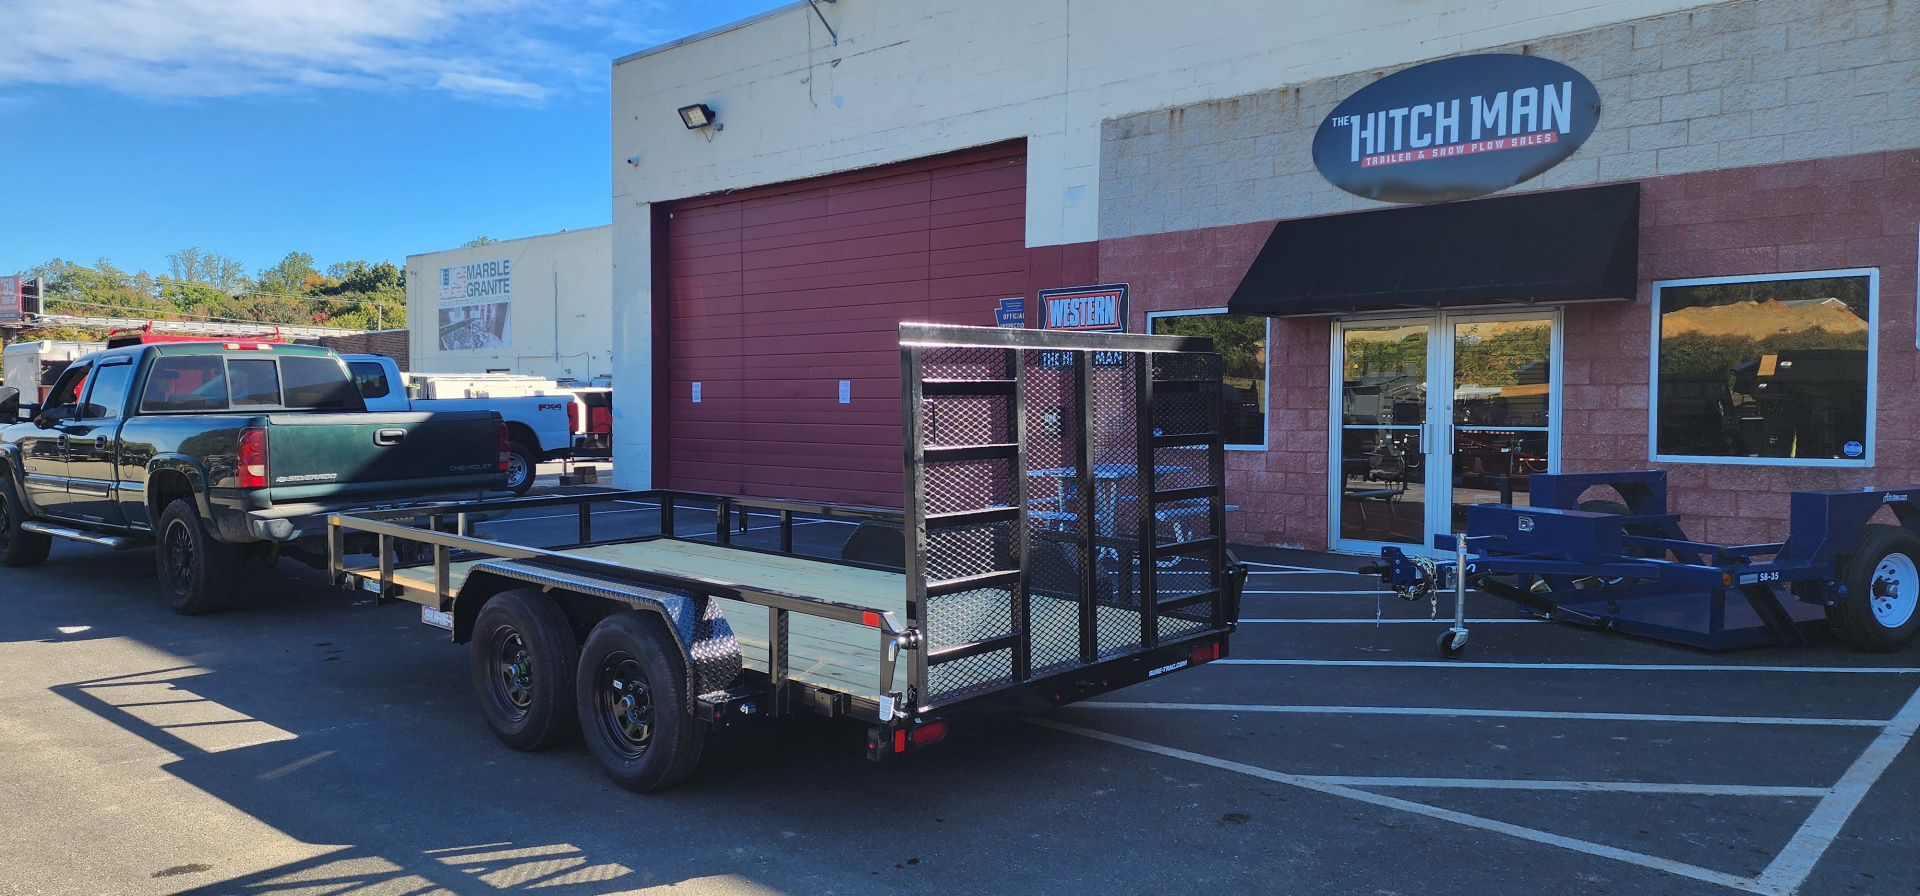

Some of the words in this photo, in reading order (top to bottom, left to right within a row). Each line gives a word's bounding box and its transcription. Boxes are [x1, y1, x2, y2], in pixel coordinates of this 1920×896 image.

[1332, 116, 1350, 128] THE
[1350, 99, 1460, 162] HITCH
[1471, 81, 1572, 140] MAN
[1366, 152, 1411, 166] TRAILER
[1418, 150, 1425, 159] &
[1432, 145, 1464, 157] SNOW
[1471, 139, 1504, 152] PLOW
[1511, 133, 1552, 147] SALES
[466, 260, 510, 280] MARBLE
[440, 266, 466, 300] US
[466, 278, 510, 297] GRANITE
[1049, 295, 1116, 328] WESTERN
[538, 403, 561, 411] FX4
[449, 463, 493, 471] CHEVROLET
[287, 473, 338, 482] SILVERADO
[1148, 659, 1188, 677] SURE-TRAC.COM
